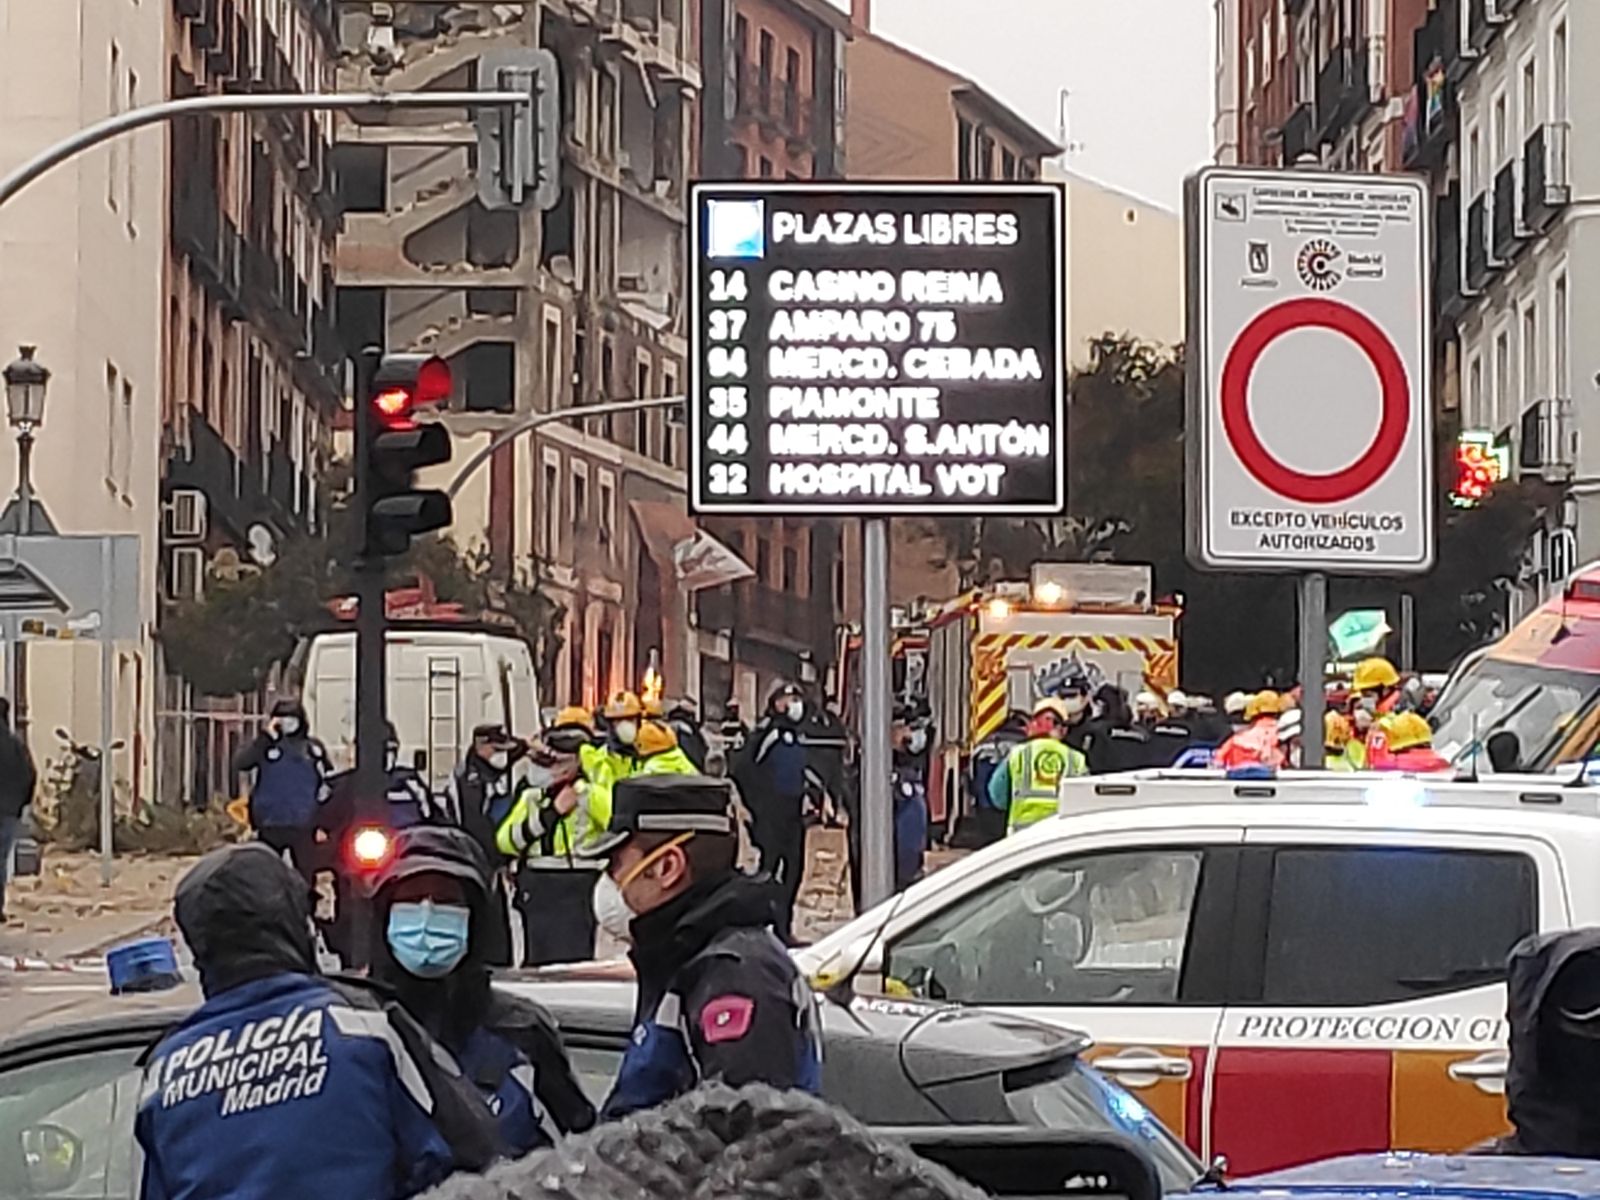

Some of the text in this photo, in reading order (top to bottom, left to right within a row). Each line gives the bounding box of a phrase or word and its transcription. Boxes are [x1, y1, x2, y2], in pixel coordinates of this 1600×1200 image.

[773, 212, 1017, 244] PLAZAS LIBRES
[769, 271, 895, 302] CASINO
[901, 271, 1003, 302] REINA
[769, 310, 910, 342] AMPARO
[917, 311, 956, 342] 75
[769, 347, 897, 379] MERCD.
[903, 348, 1041, 380] CEBADA
[709, 387, 939, 419] 35 PIAMONTE
[708, 418, 1049, 456] 44 MERCD. S.ANTÓN
[770, 463, 931, 496] HOSPITAL
[936, 464, 1005, 496] VOT
[1232, 512, 1305, 527] EXCEPTO
[1260, 534, 1374, 551] AUTORIZADOS
[164, 1005, 323, 1083] POLICÍA
[1238, 1016, 1461, 1040] PROTECCION
[162, 1039, 328, 1109] MUNICIPAL
[220, 1066, 328, 1116] Madrid
